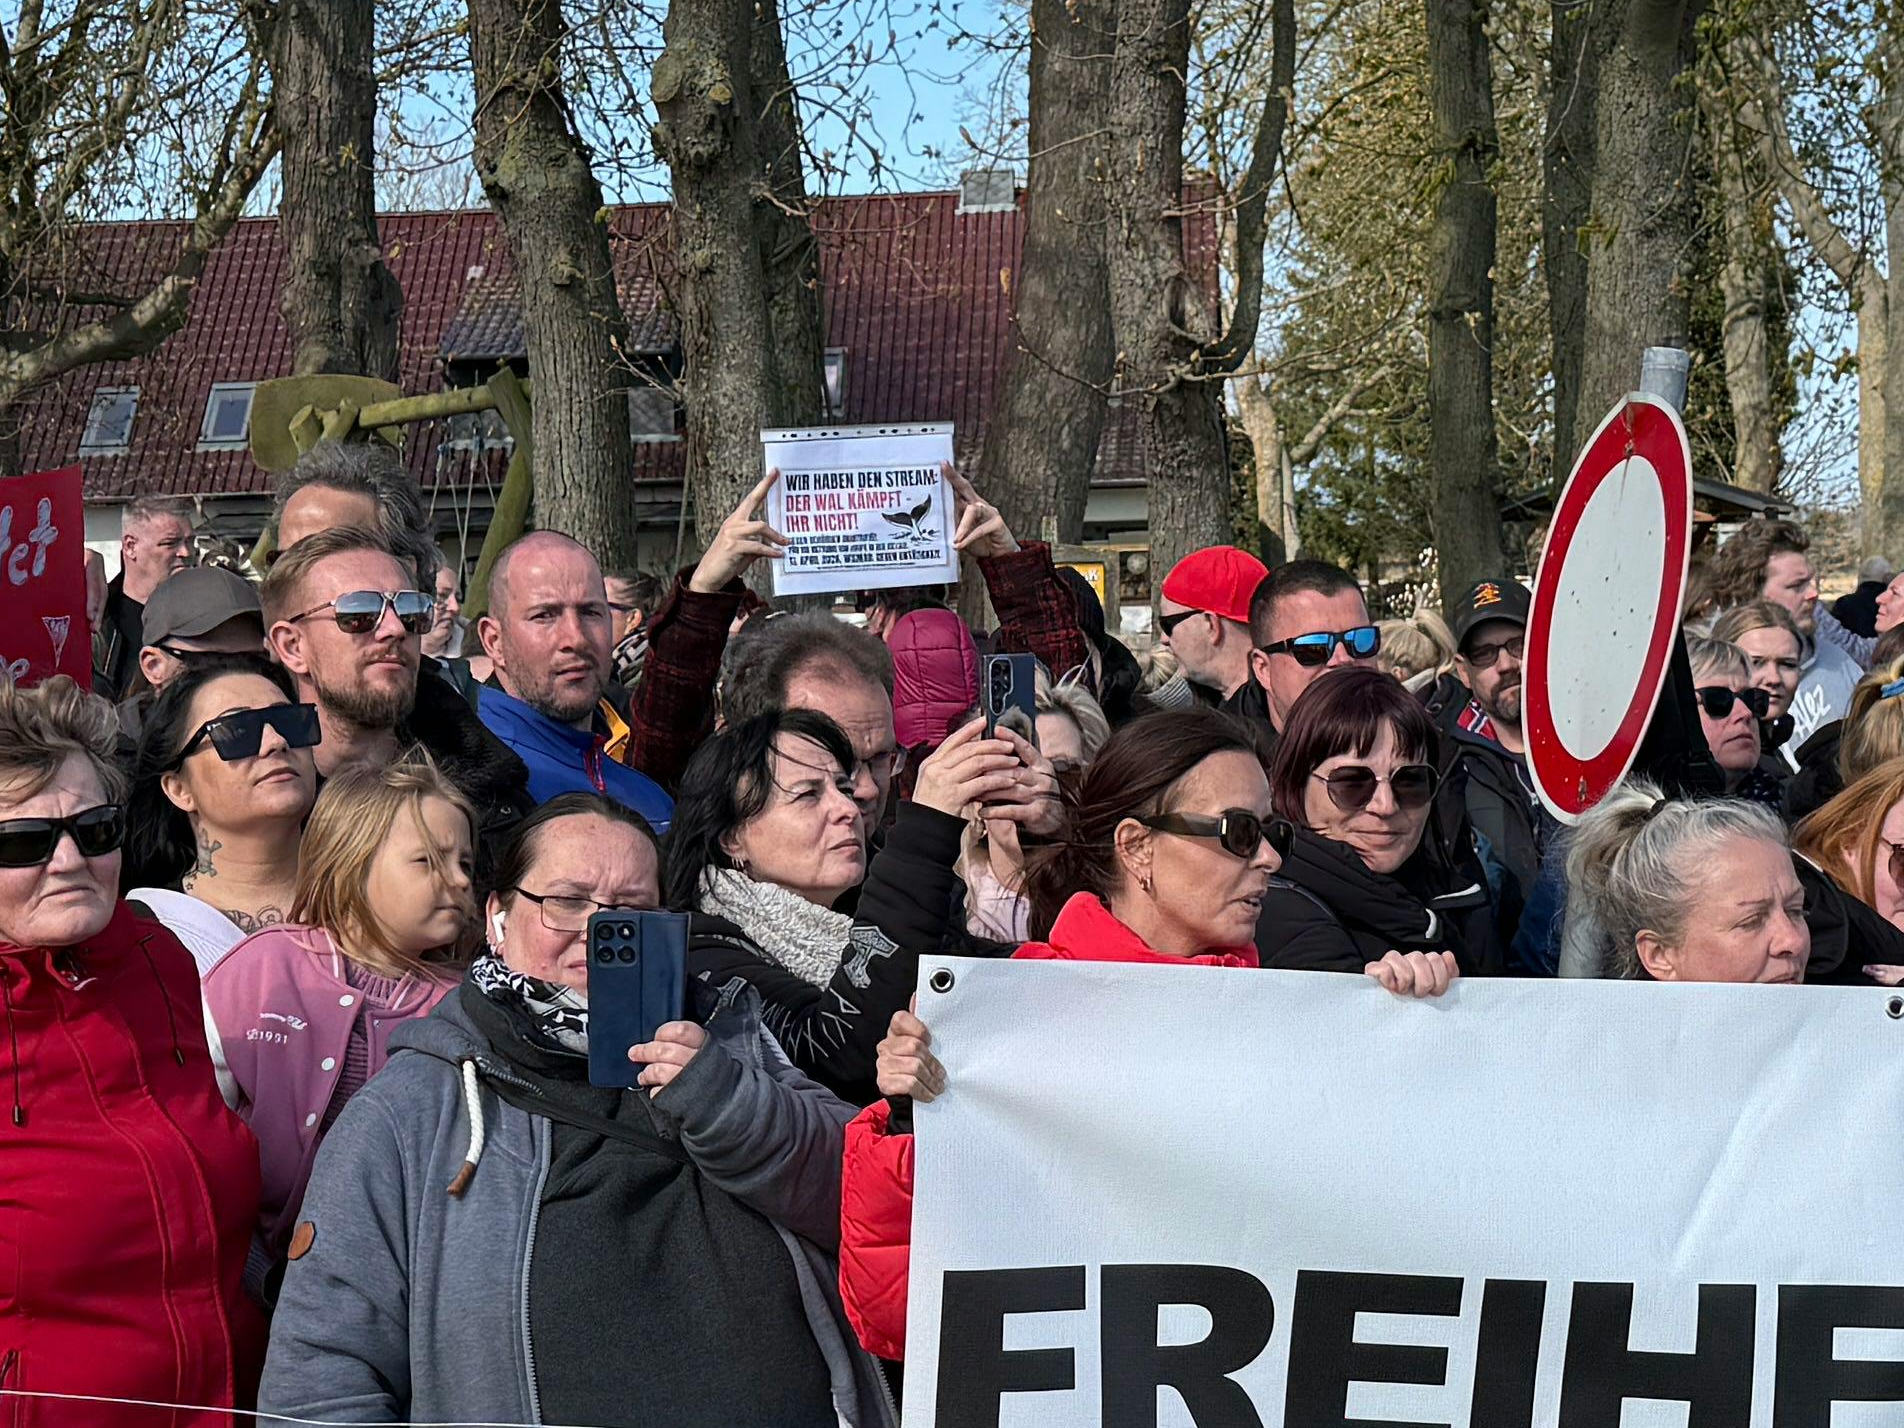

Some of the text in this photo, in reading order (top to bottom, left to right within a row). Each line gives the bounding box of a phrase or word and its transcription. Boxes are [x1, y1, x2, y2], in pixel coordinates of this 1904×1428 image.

[785, 474, 810, 491] WIR
[813, 472, 854, 490] HABEN
[858, 471, 882, 489] DEN
[786, 494, 811, 512] DER
[814, 493, 845, 511] WAL
[848, 489, 902, 510] KÄMPFT
[786, 513, 859, 533] IHR NICHT!
